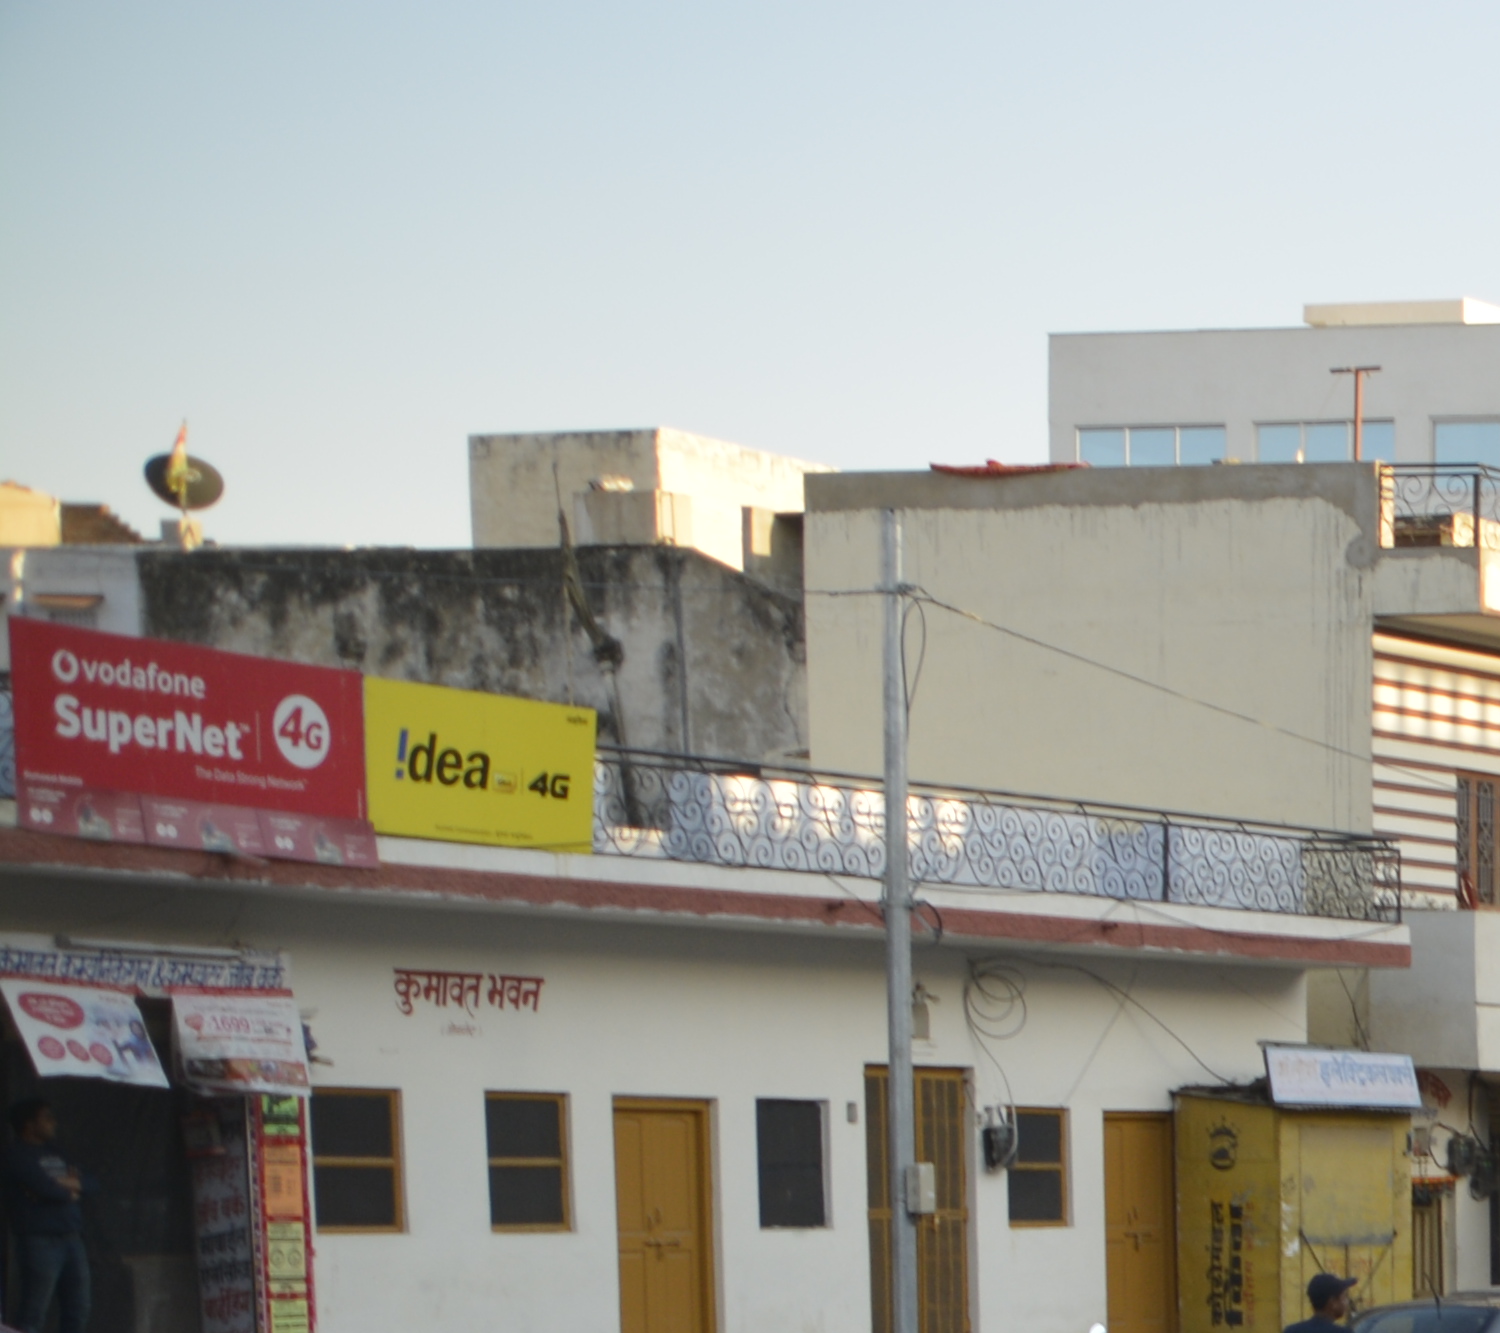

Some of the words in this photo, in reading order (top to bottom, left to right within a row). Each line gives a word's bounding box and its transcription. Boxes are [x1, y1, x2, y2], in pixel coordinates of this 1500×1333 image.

[81, 658, 206, 699] vodafone
[278, 704, 324, 751] 4G
[528, 772, 571, 801] 4G
[392, 967, 484, 1019] कुमावत
[487, 971, 545, 1013] भवन
